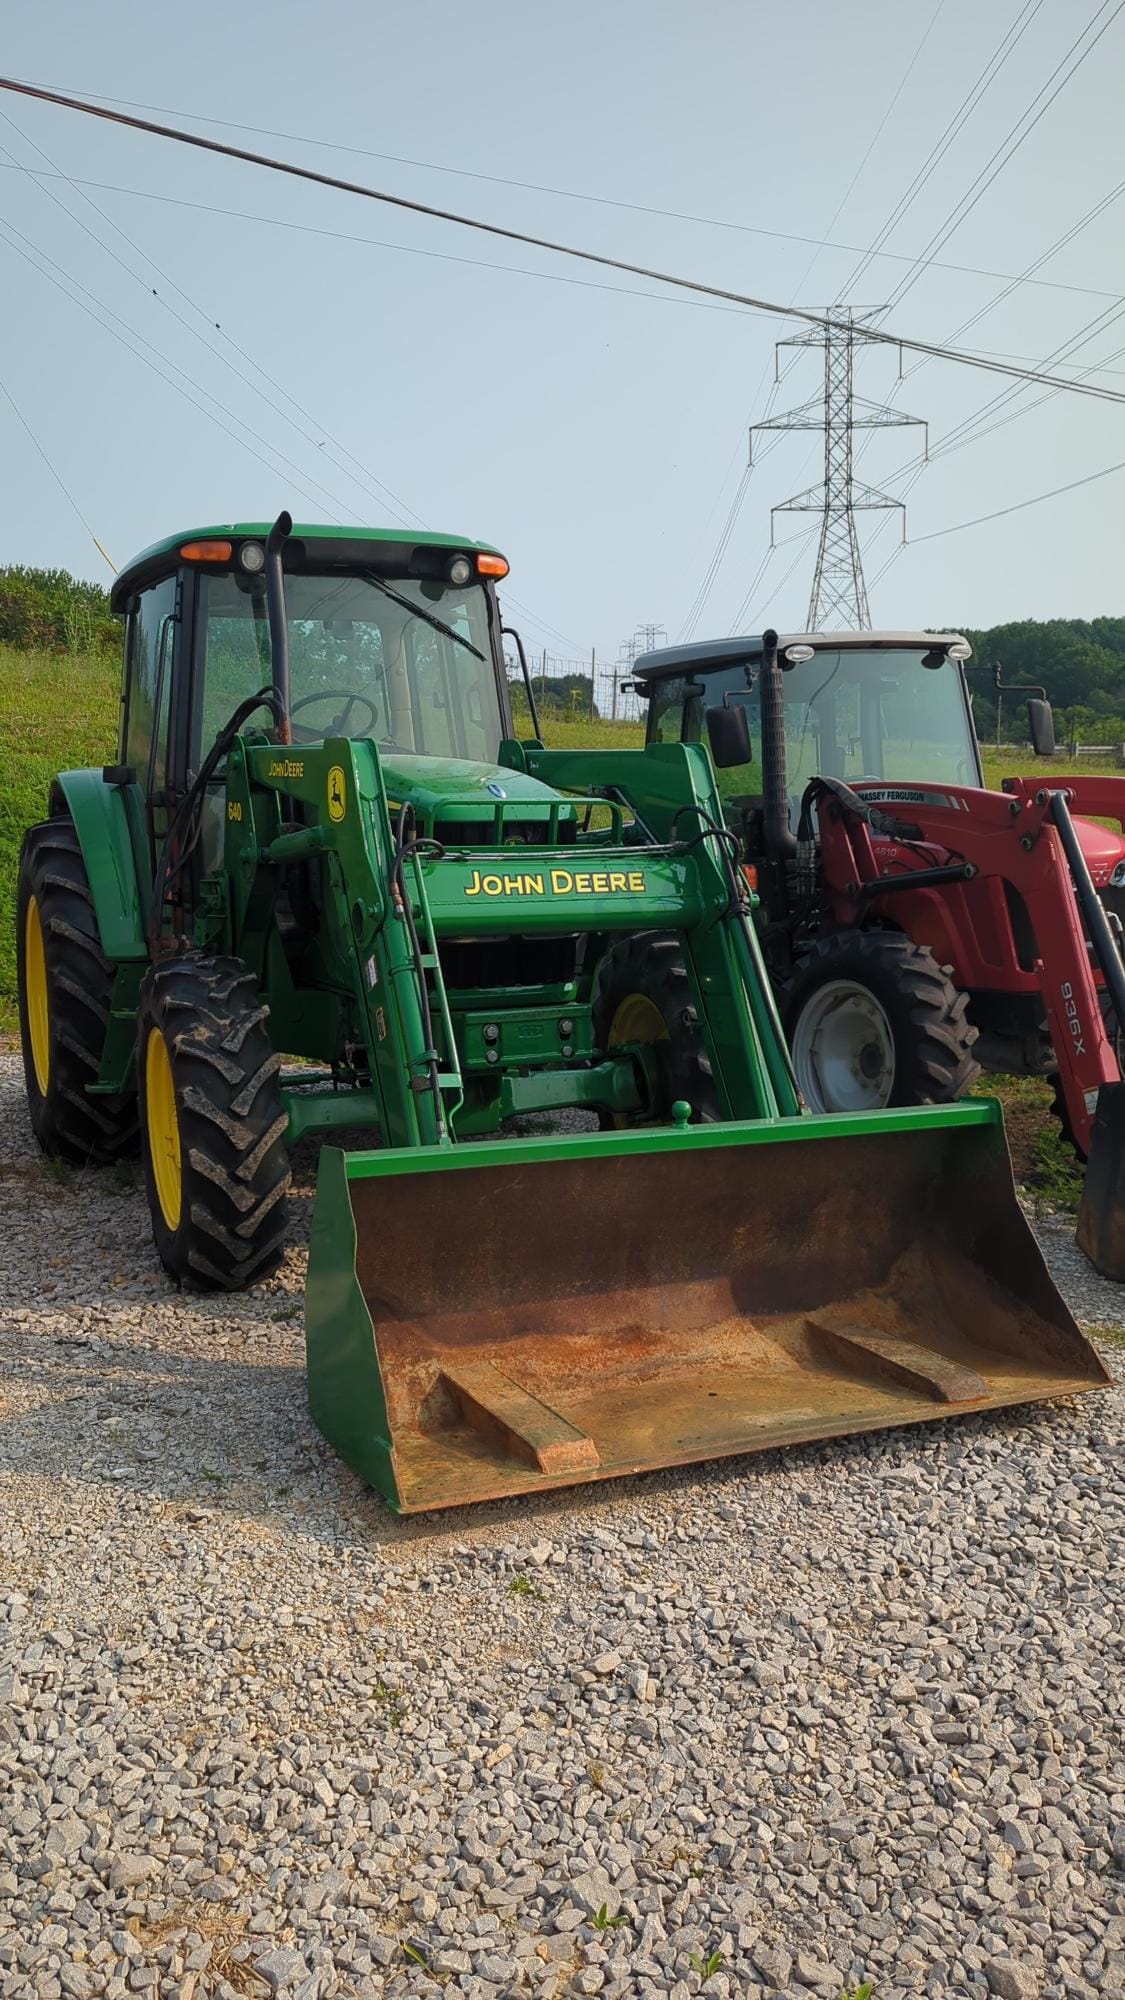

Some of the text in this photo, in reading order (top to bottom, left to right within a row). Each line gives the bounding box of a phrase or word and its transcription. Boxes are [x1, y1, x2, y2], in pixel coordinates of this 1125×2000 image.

[284, 759, 304, 777] DEERE
[887, 791, 925, 801] FERGUSON
[228, 802, 242, 821] 640
[464, 868, 646, 897] JOHN DEERE
[1061, 982, 1086, 1056] 936X
